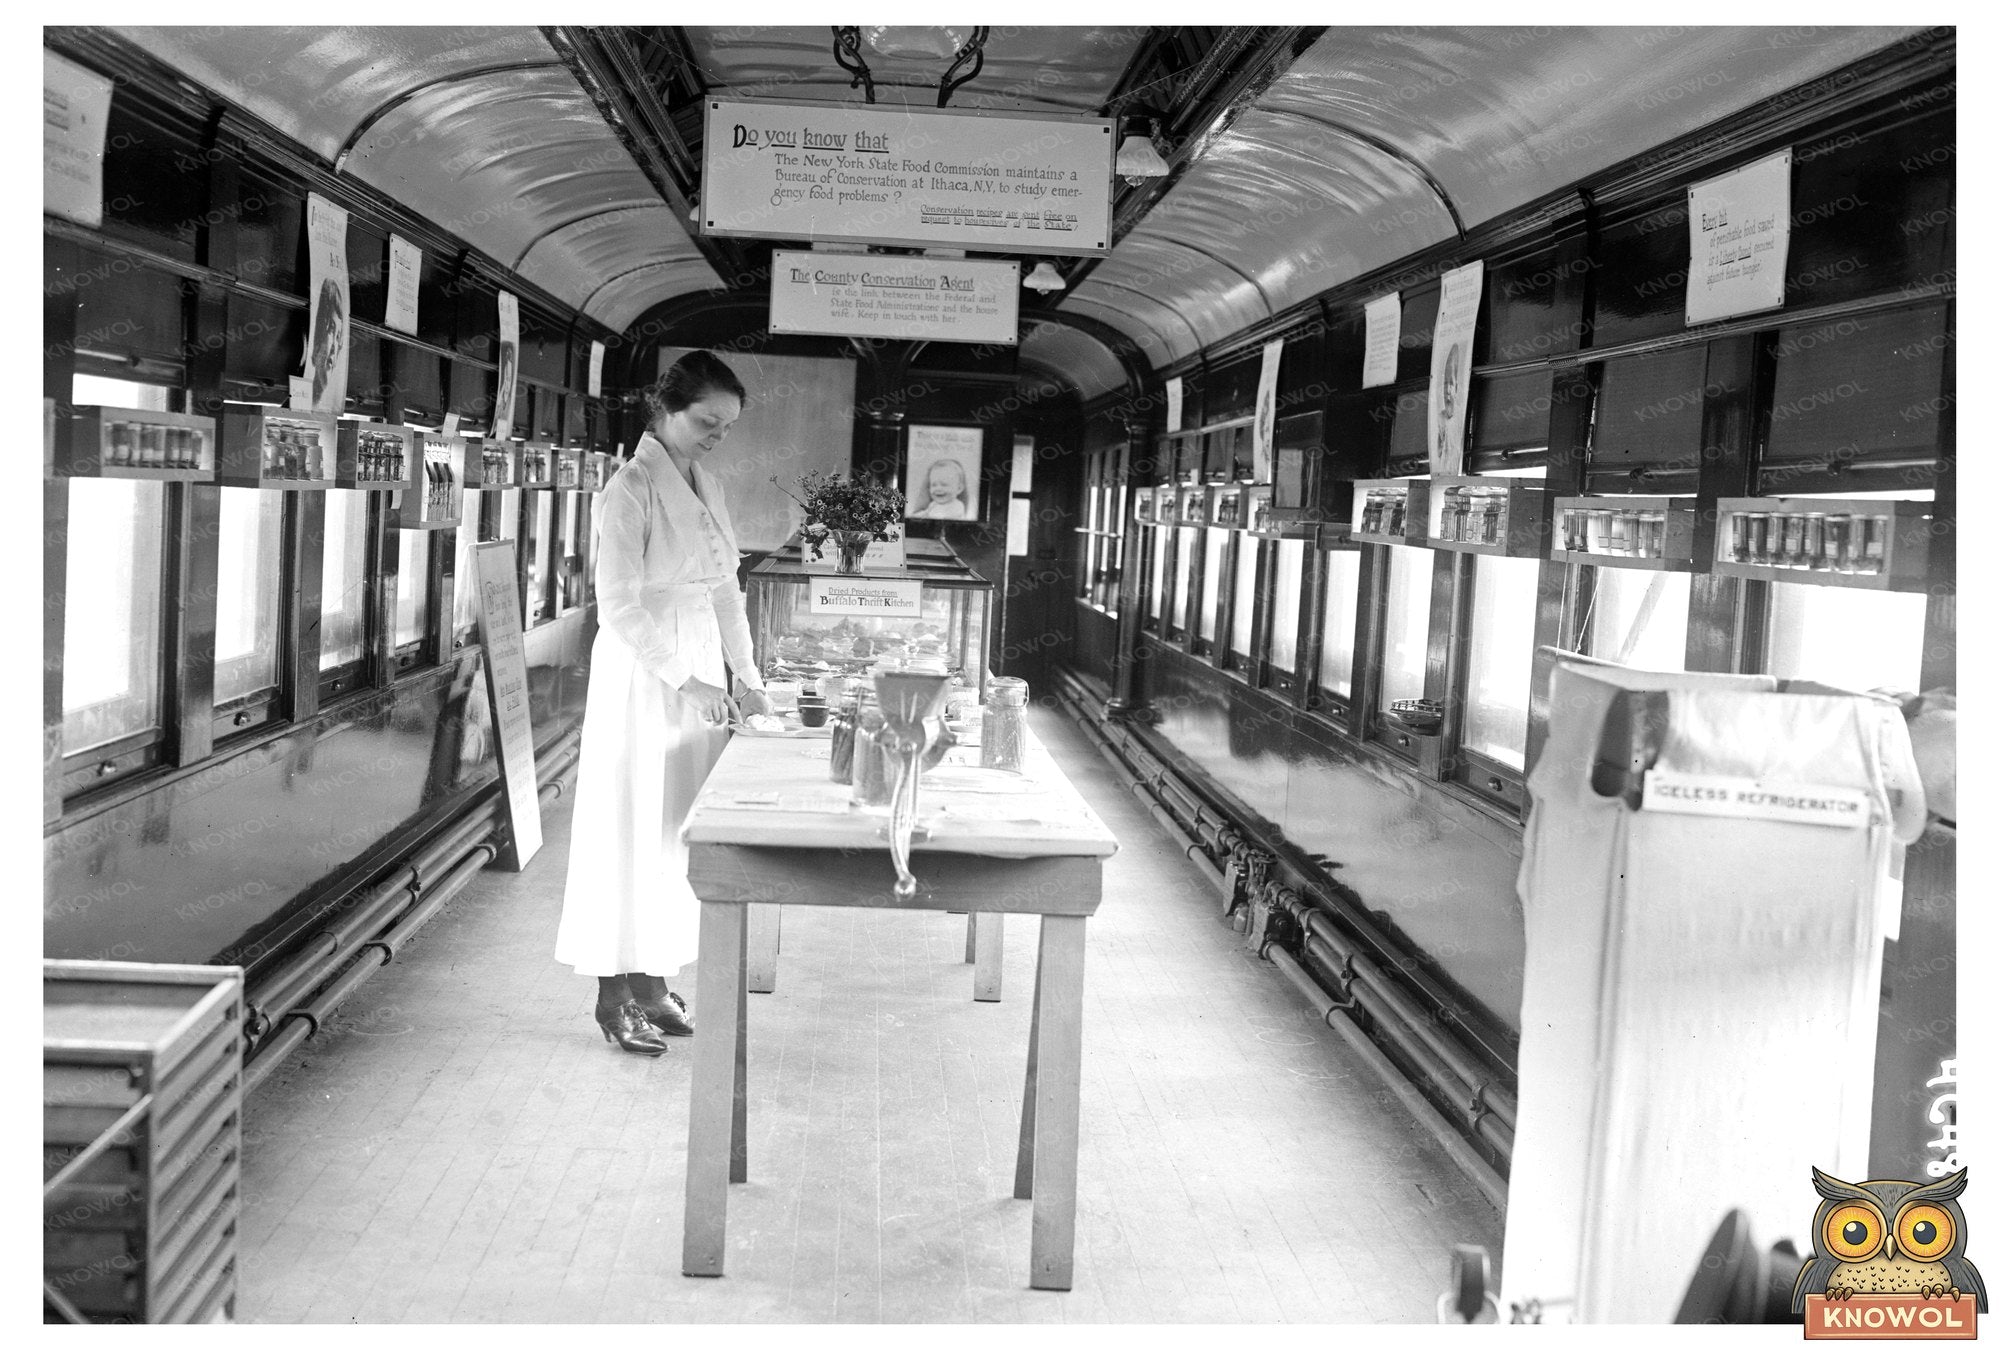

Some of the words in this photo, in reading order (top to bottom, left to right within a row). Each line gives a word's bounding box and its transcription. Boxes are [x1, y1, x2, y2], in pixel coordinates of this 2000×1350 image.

[732, 123, 759, 149] Do
[758, 129, 797, 151] you
[803, 127, 847, 149] know
[854, 129, 889, 152] that
[774, 152, 798, 166] The
[803, 154, 833, 167] New
[836, 155, 865, 169] York
[868, 156, 899, 171] State
[902, 159, 930, 173] Food
[934, 160, 1000, 177] Commission
[1005, 164, 1065, 181] maintains
[1069, 170, 1078, 181] a
[774, 168, 816, 183] Bureau
[819, 168, 837, 184] of
[837, 172, 907, 189] Conservation
[911, 176, 924, 189] at
[999, 182, 1010, 194] to
[1014, 183, 1047, 200] study
[1051, 186, 1083, 198] emer-
[770, 183, 806, 206] gency
[809, 184, 834, 200] food
[838, 188, 889, 205] problems
[920, 204, 974, 216] Conservation
[976, 208, 1003, 219] recipes
[1005, 210, 1019, 219] are
[1022, 209, 1040, 220] sent
[1065, 212, 1078, 222] on
[921, 215, 950, 225] request
[953, 216, 963, 225] to
[1027, 219, 1040, 229] the
[790, 268, 810, 282] The
[814, 270, 860, 284] County
[861, 272, 936, 289] Conservation
[940, 275, 975, 291] Agent
[843, 287, 858, 297] the
[861, 288, 879, 298] link
[882, 289, 921, 300] between
[925, 291, 941, 301] the
[944, 292, 975, 303] Federal
[979, 294, 997, 304] and
[830, 298, 853, 308] State
[855, 299, 874, 309] Food
[942, 302, 957, 313] and
[960, 303, 973, 314] the
[857, 309, 879, 321] Keep
[883, 311, 891, 320] in
[894, 311, 917, 321] touch
[920, 313, 939, 323] with
[828, 586, 849, 596] Dried
[851, 587, 881, 597] Products
[881, 588, 898, 597] from
[820, 595, 857, 606] Buffalo
[857, 596, 883, 607] Thrift
[884, 598, 914, 608] Kitchen
[1654, 785, 1728, 800] ICELESS
[1737, 792, 1858, 812] REFRIGERATOR
